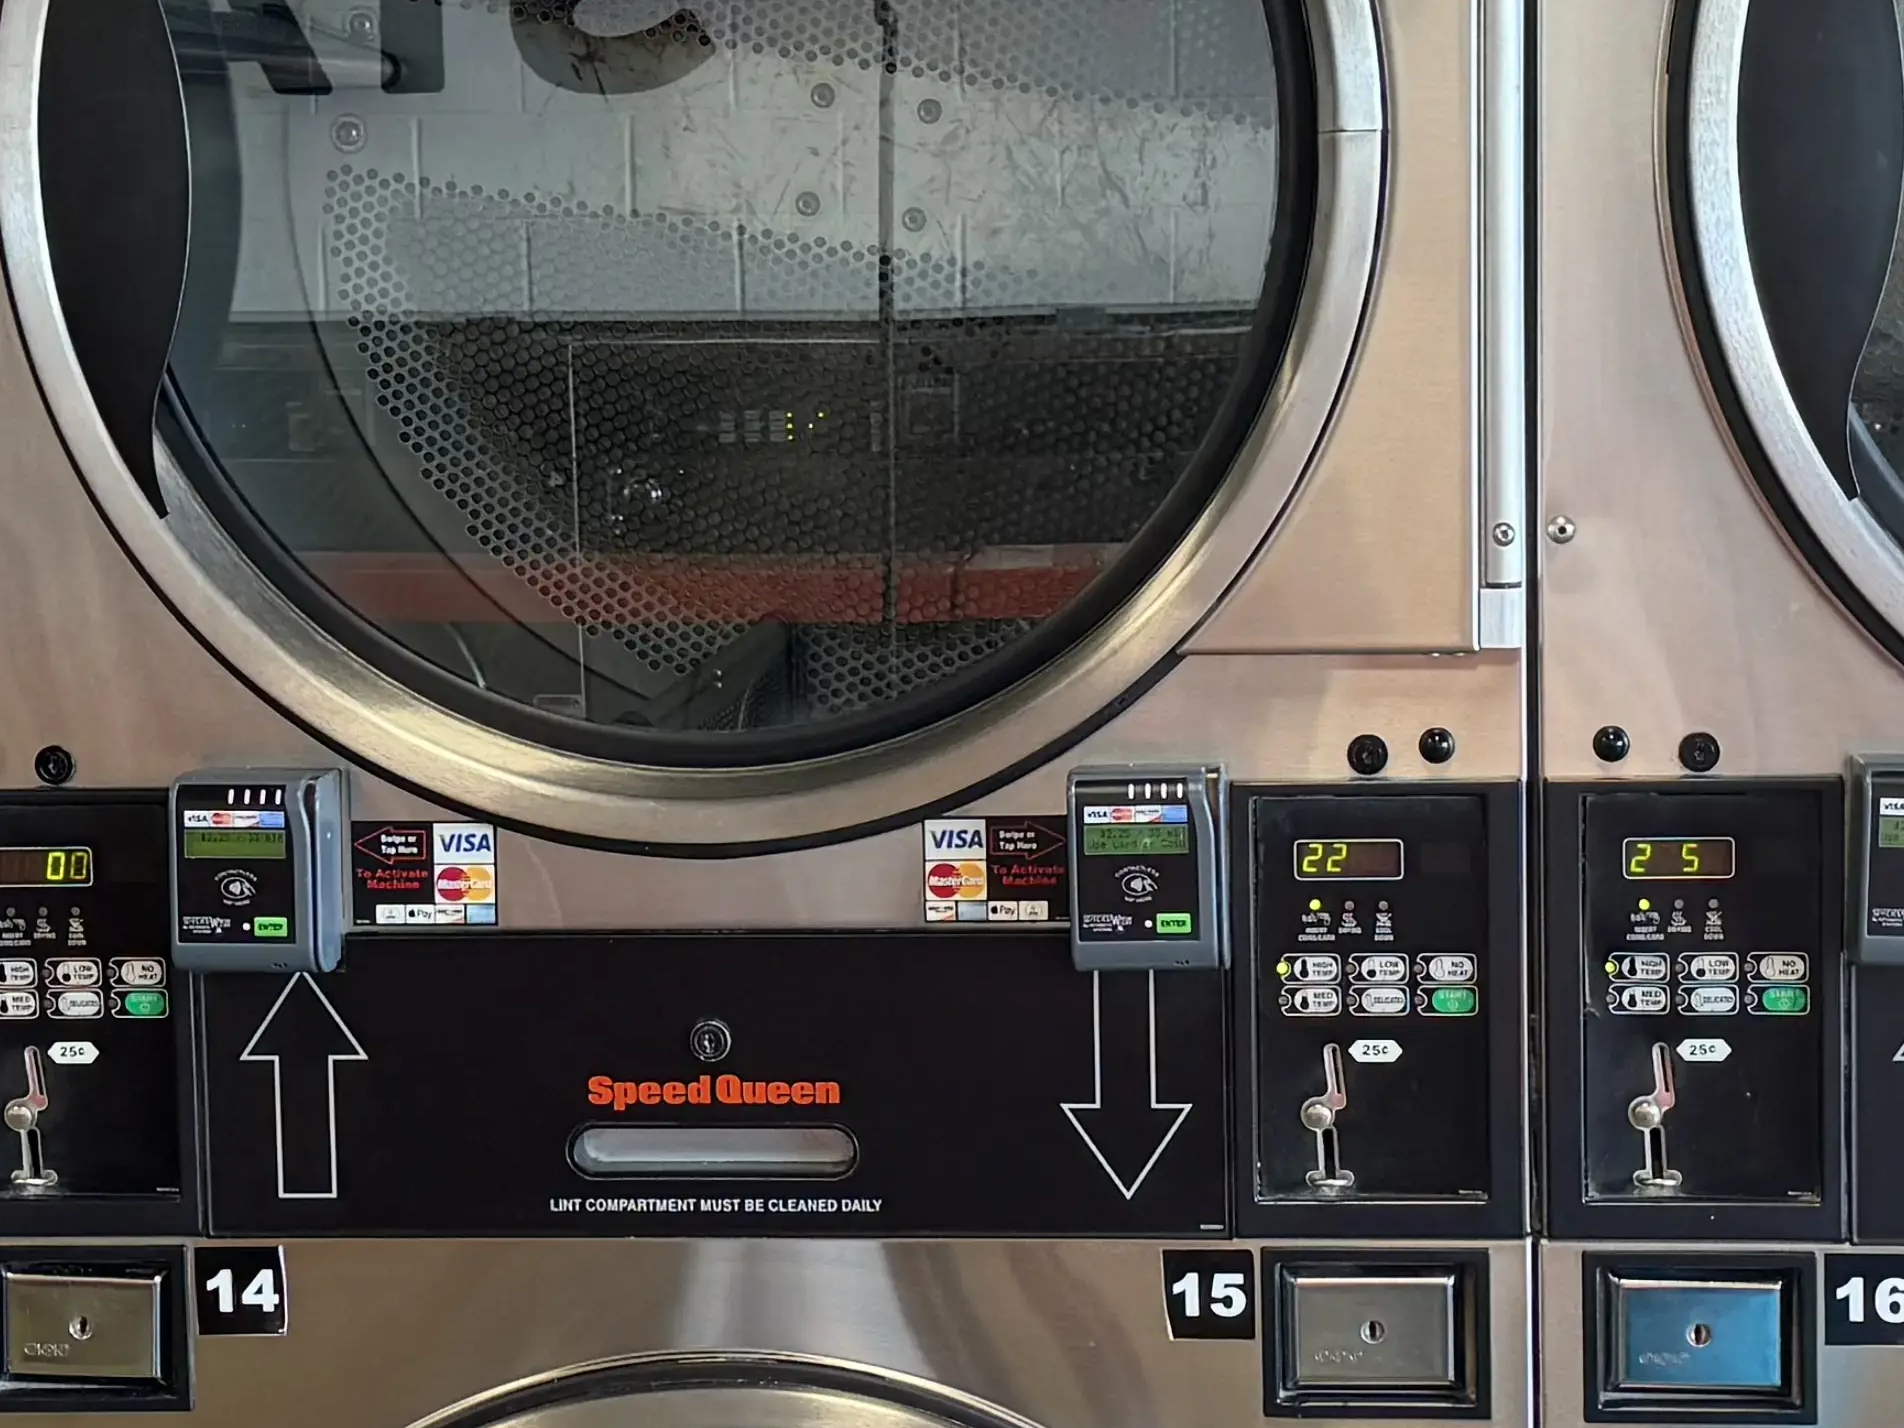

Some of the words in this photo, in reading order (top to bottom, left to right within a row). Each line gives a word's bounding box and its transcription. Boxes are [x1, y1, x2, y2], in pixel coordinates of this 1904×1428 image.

[440, 834, 491, 852] VISA
[930, 830, 983, 848] VISA
[1302, 844, 1347, 872] 22
[588, 1075, 711, 1110] Speed
[716, 1075, 840, 1105] Queen
[550, 1199, 581, 1212] LINT
[586, 1199, 696, 1212] COMPARTMENT
[701, 1199, 740, 1212] MUST
[745, 1199, 764, 1212] BE
[769, 1199, 837, 1212] CLEANED
[842, 1199, 881, 1212] DAILY
[206, 1269, 279, 1313] 14
[1172, 1273, 1246, 1317] 15
